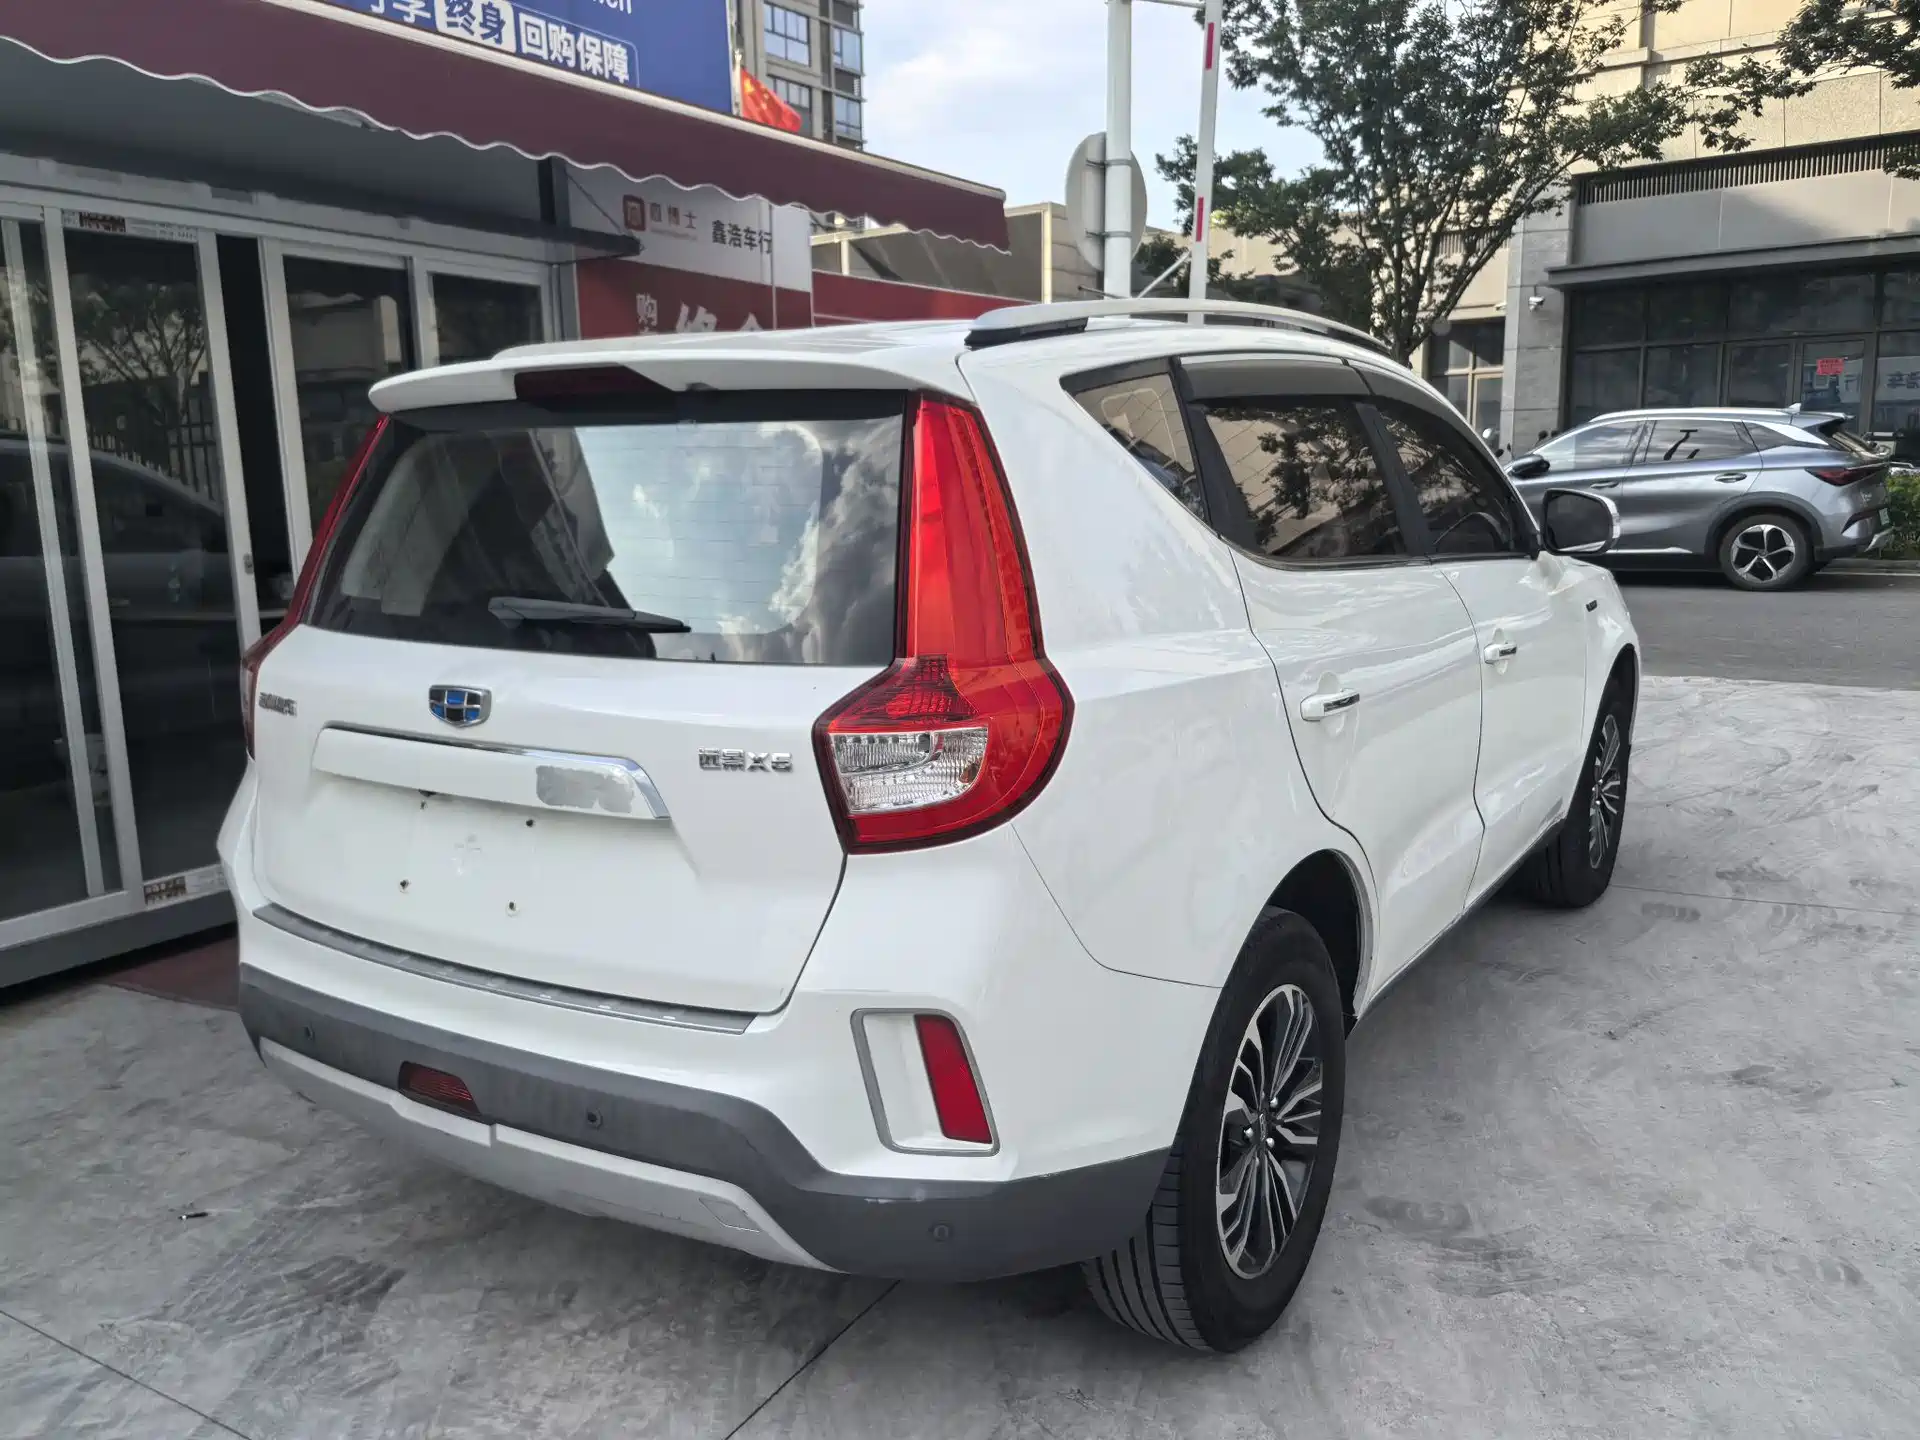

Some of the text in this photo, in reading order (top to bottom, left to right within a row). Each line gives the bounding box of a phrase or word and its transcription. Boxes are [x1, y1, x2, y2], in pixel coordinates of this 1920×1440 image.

[370, 0, 630, 84] 终身回购保障
[712, 220, 772, 254] 鑫浩车行
[636, 293, 658, 333] 购
[698, 747, 793, 772] 远景X6
